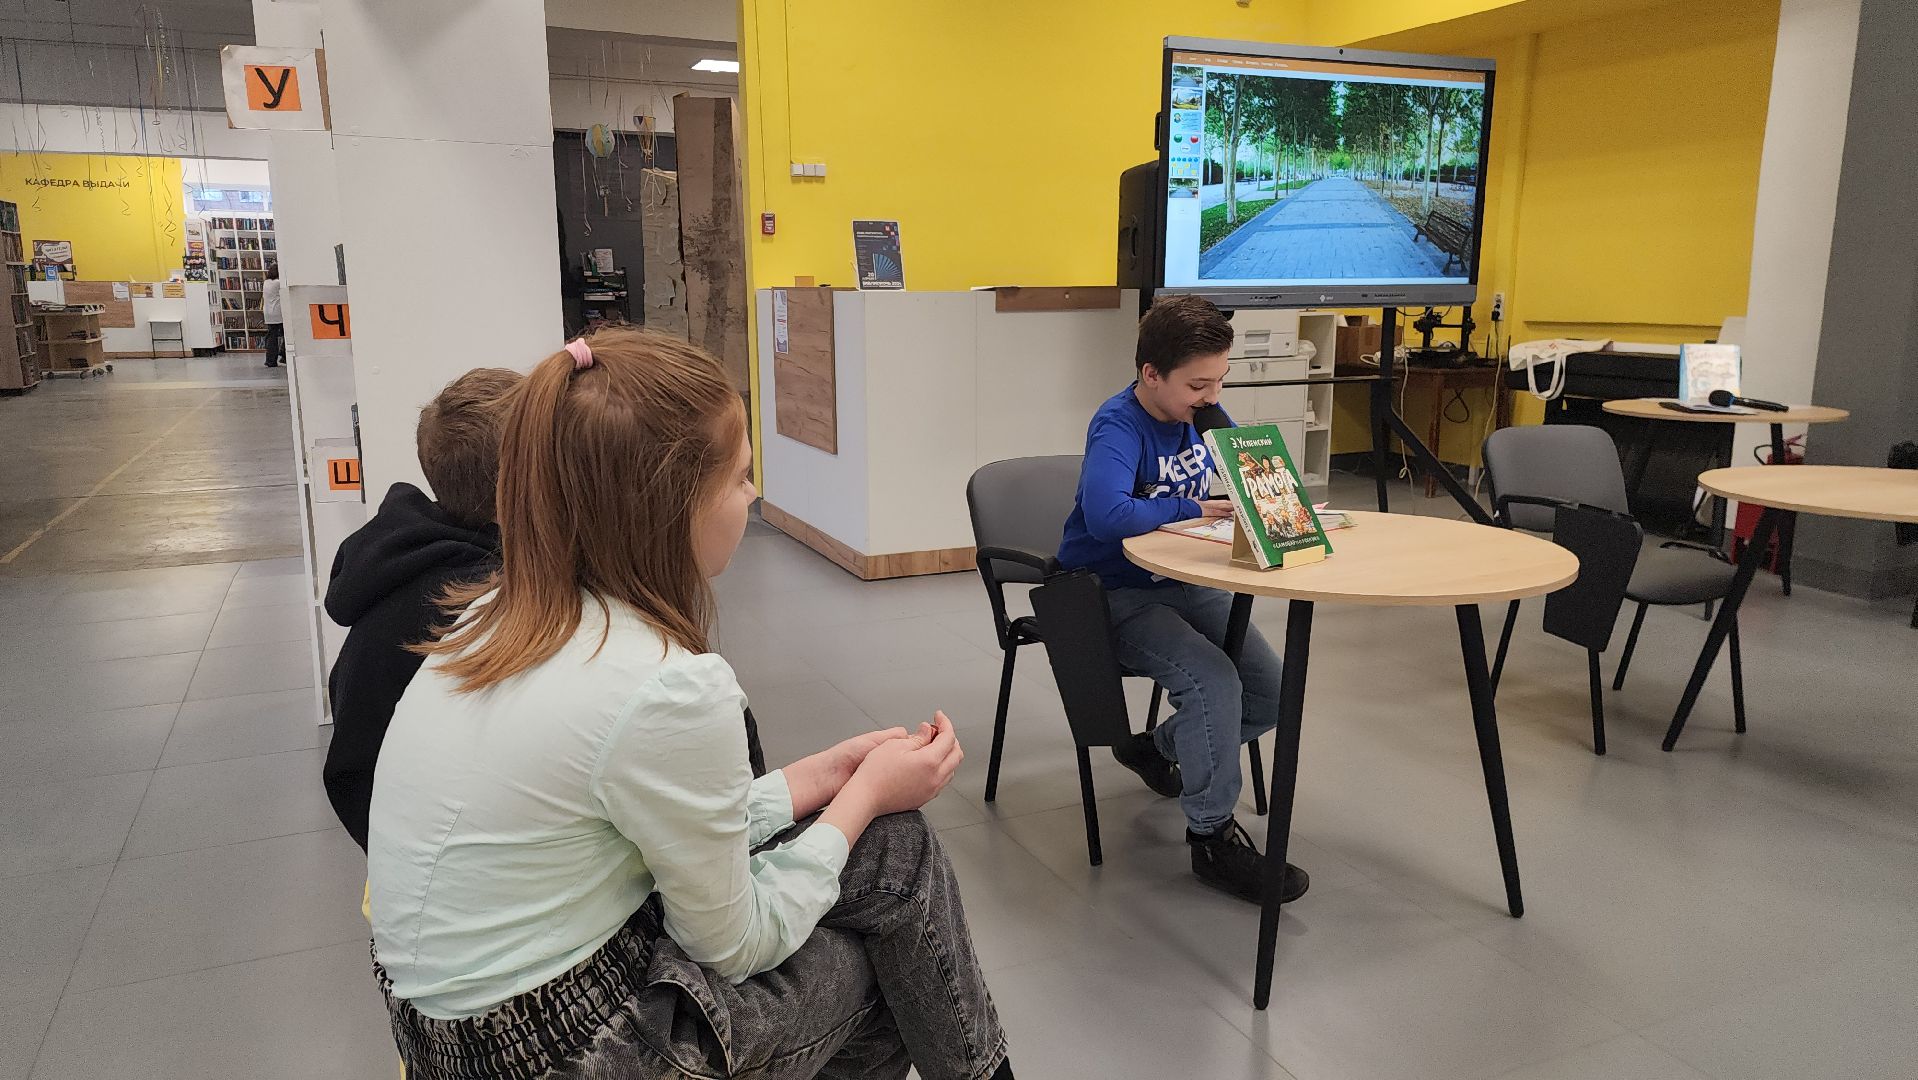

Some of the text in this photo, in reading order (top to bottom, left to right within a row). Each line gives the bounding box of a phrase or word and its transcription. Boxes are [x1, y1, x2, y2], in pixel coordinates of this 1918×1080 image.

[254, 67, 291, 109] У
[25, 177, 130, 189] КАФЕДРА ВЫДАЧИ
[318, 304, 346, 337] Ч
[1157, 443, 1207, 483] KEEP
[1239, 467, 1299, 504] ГРАМОТА
